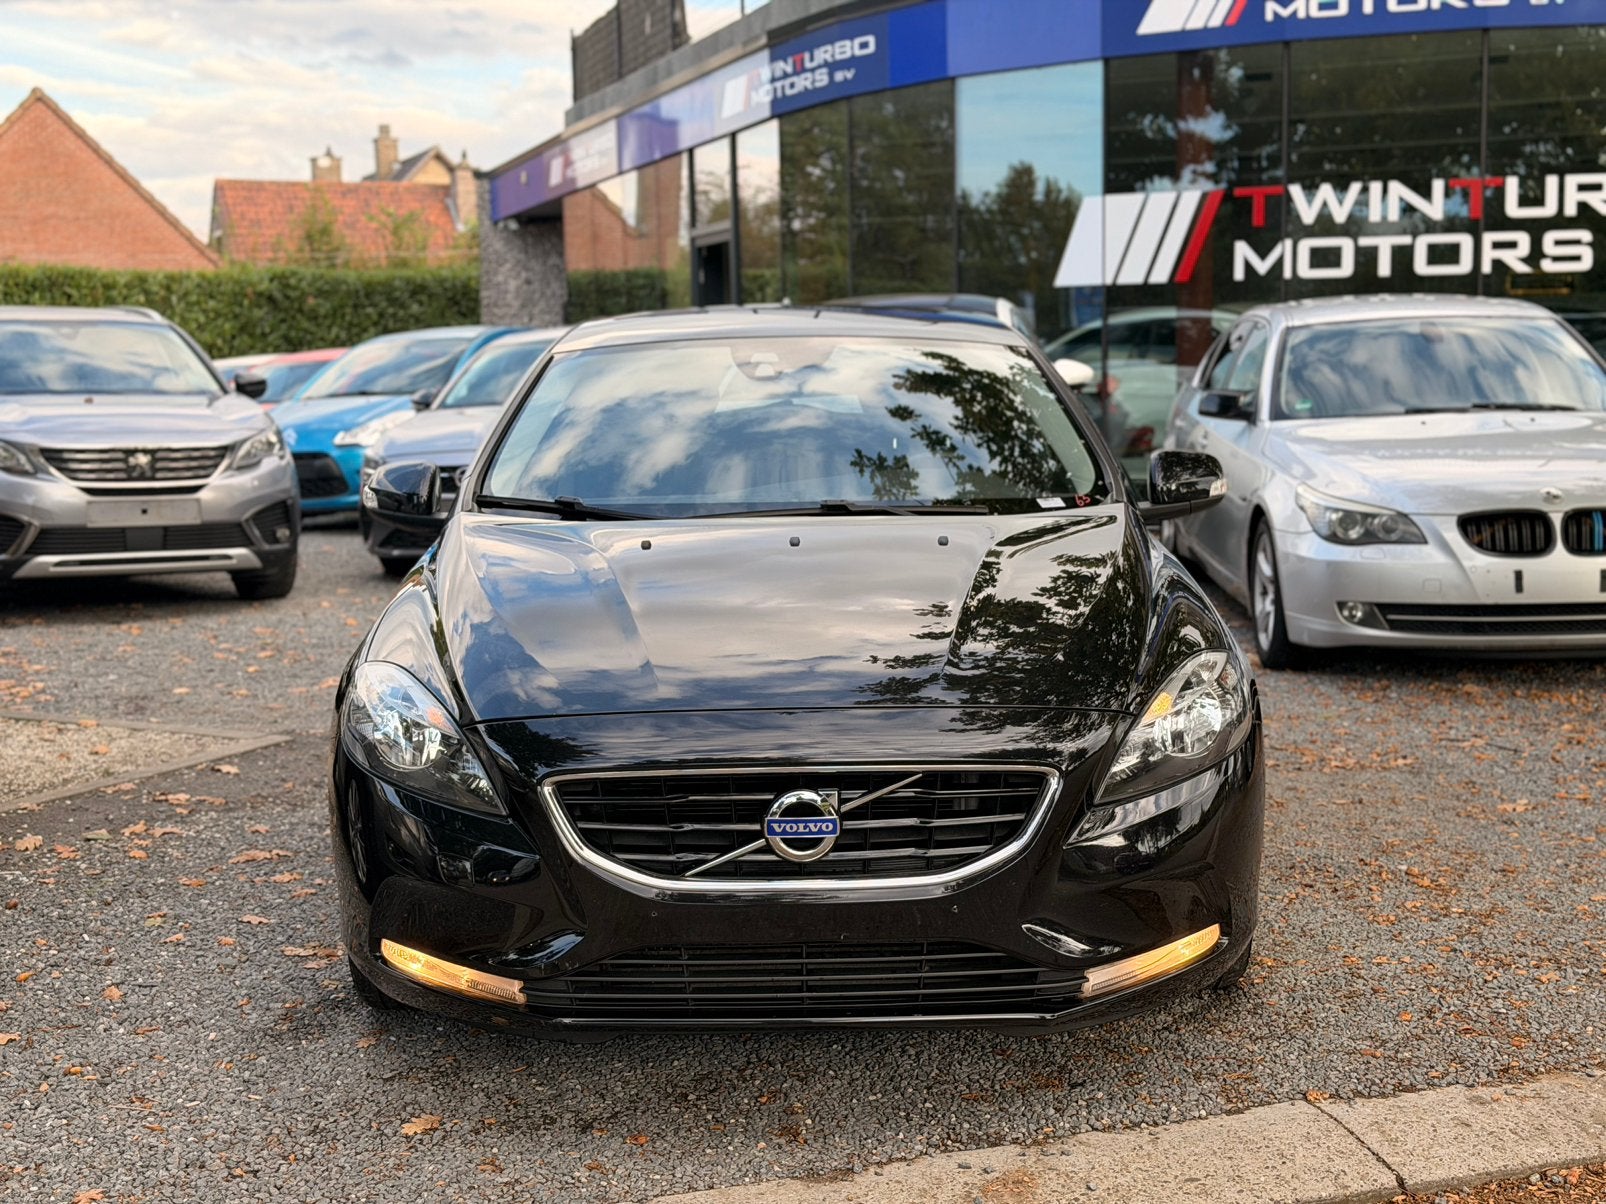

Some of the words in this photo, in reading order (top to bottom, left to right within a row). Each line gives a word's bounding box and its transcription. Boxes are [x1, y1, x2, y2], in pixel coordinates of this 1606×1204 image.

[1264, 0, 1511, 22] MOT
[750, 67, 830, 108] MOTORS
[1233, 172, 1606, 229] TWINTUR
[1232, 228, 1594, 282] MOTORS
[771, 822, 834, 833] VOLVO
